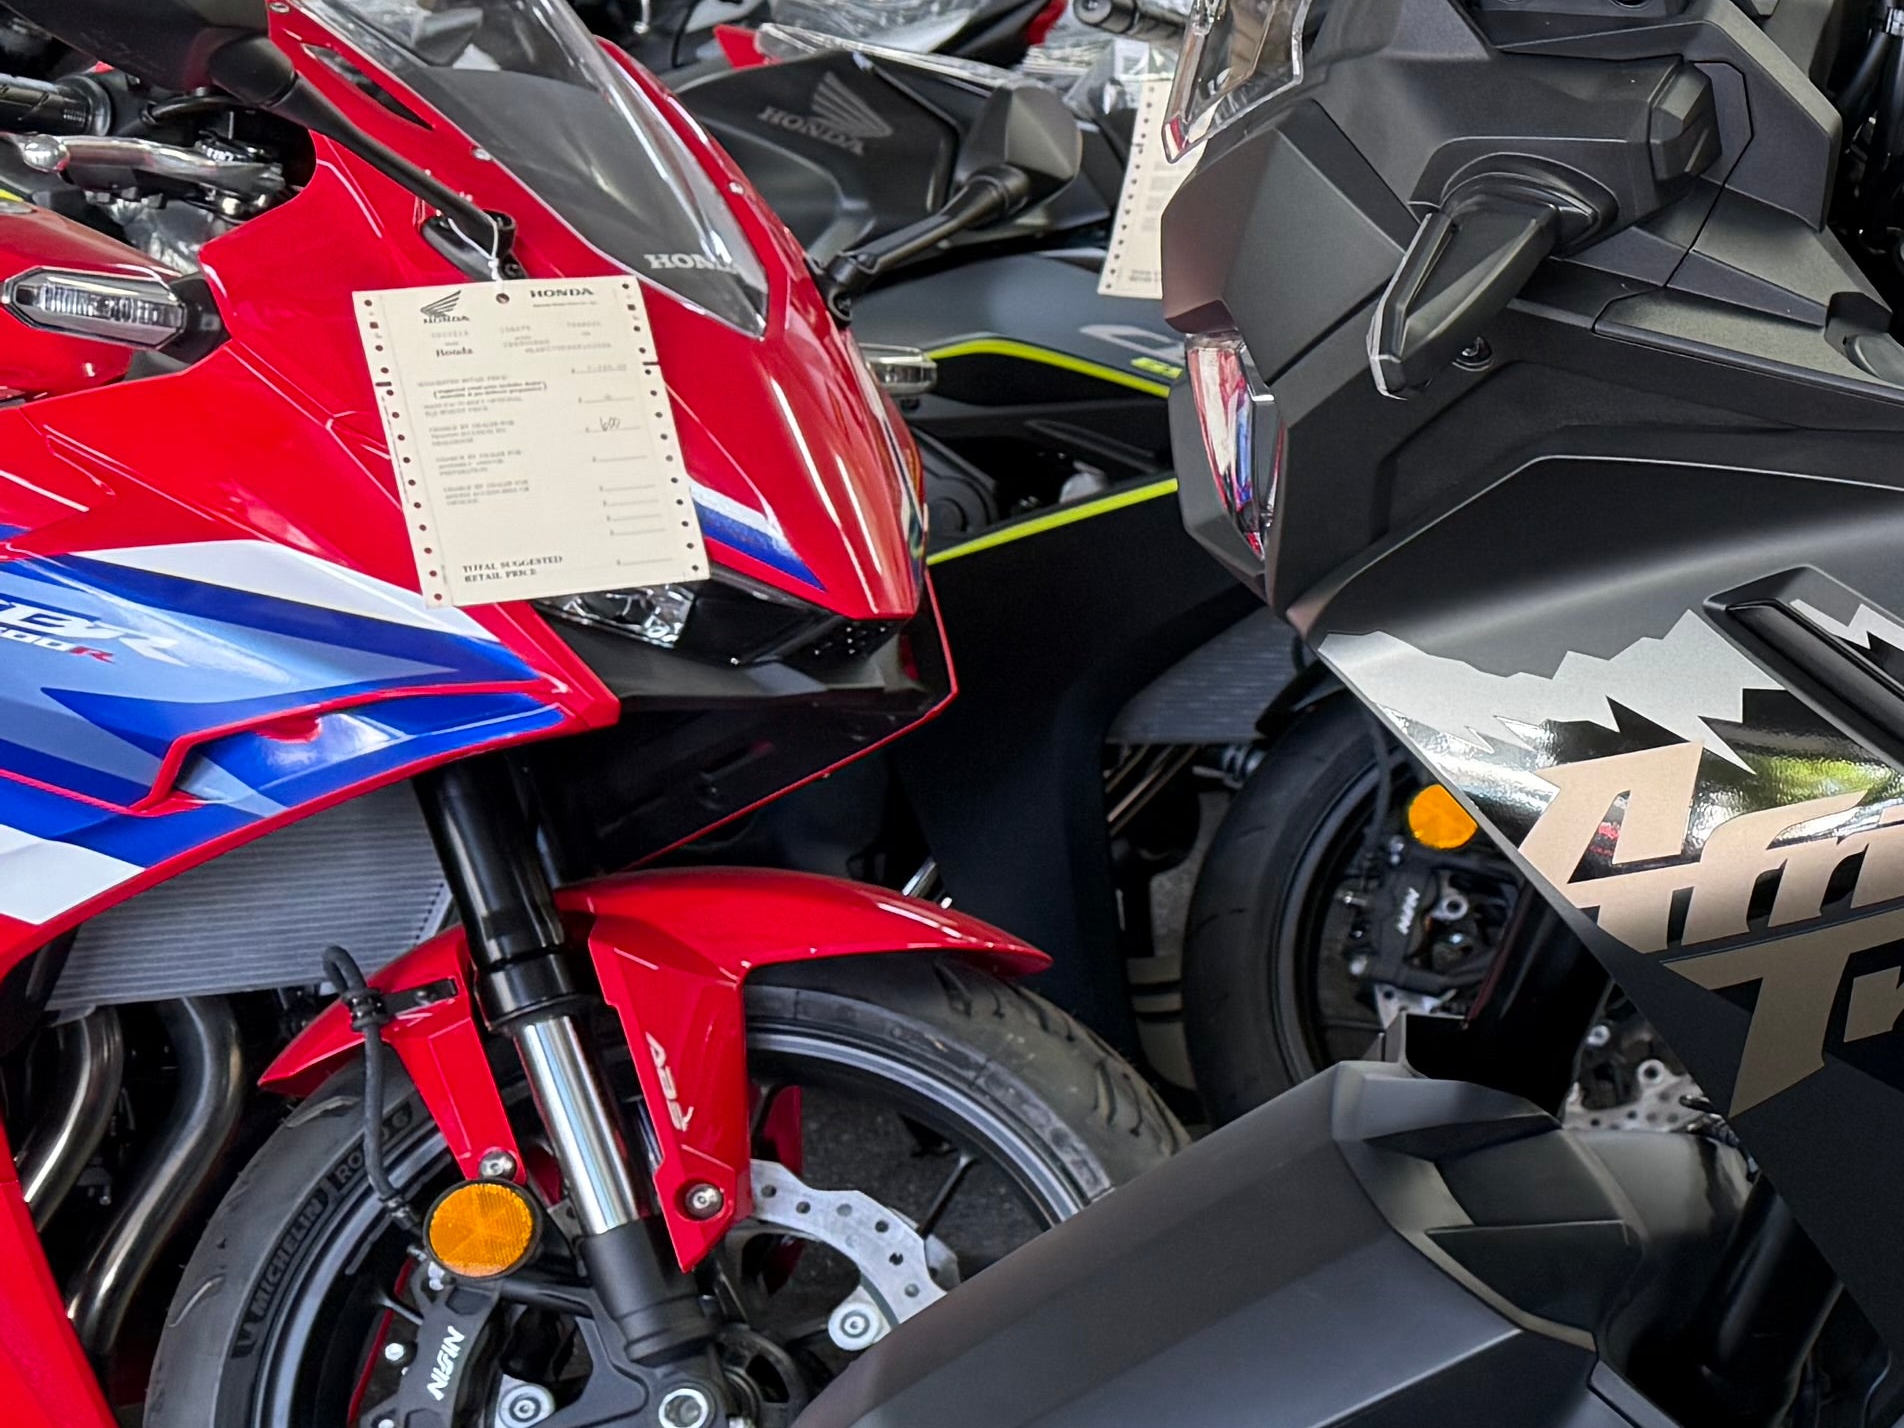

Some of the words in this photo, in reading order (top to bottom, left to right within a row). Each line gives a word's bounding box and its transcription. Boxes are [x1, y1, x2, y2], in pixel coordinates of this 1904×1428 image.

[757, 106, 864, 156] HONDA
[530, 288, 595, 299] HONDA
[463, 561, 497, 573] TOTAL
[464, 571, 502, 583] RETAIL
[0, 599, 192, 668] BR
[0, 627, 115, 664] 00R
[250, 1198, 325, 1320] MICHELIN
